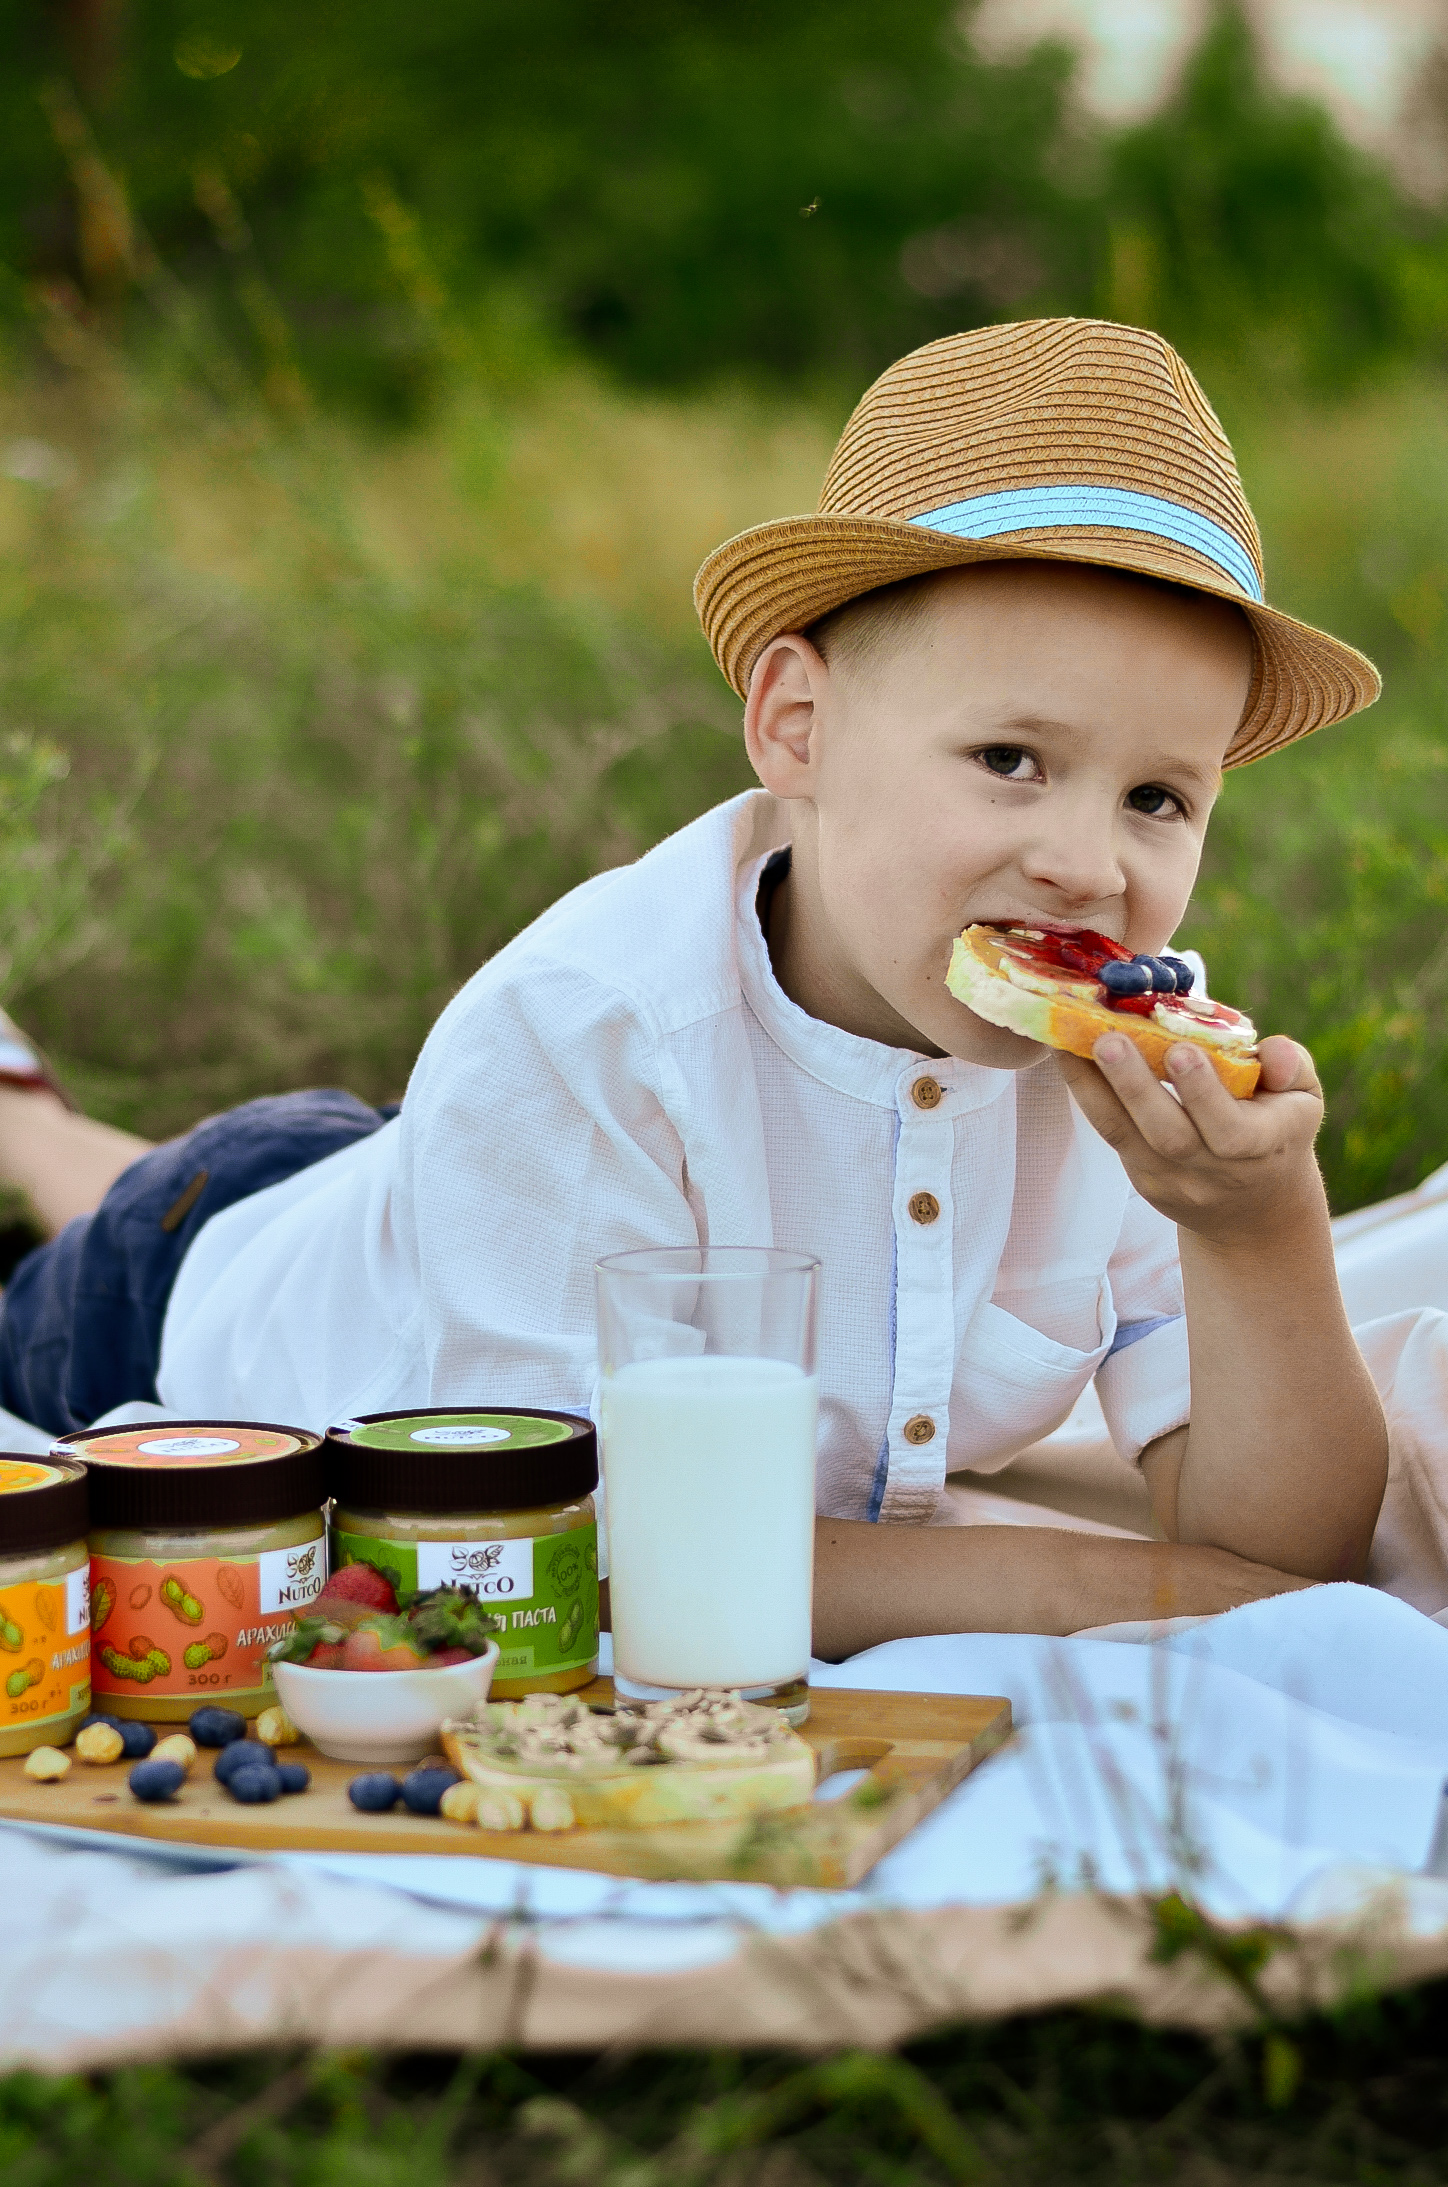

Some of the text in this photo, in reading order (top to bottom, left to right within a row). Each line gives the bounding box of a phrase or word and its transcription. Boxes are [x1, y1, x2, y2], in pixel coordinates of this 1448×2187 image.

[278, 1582, 321, 1604] NUTCO
[512, 1606, 557, 1630] ПАСТА
[188, 1673, 220, 1685] 300
[10, 1700, 39, 1714] 300
